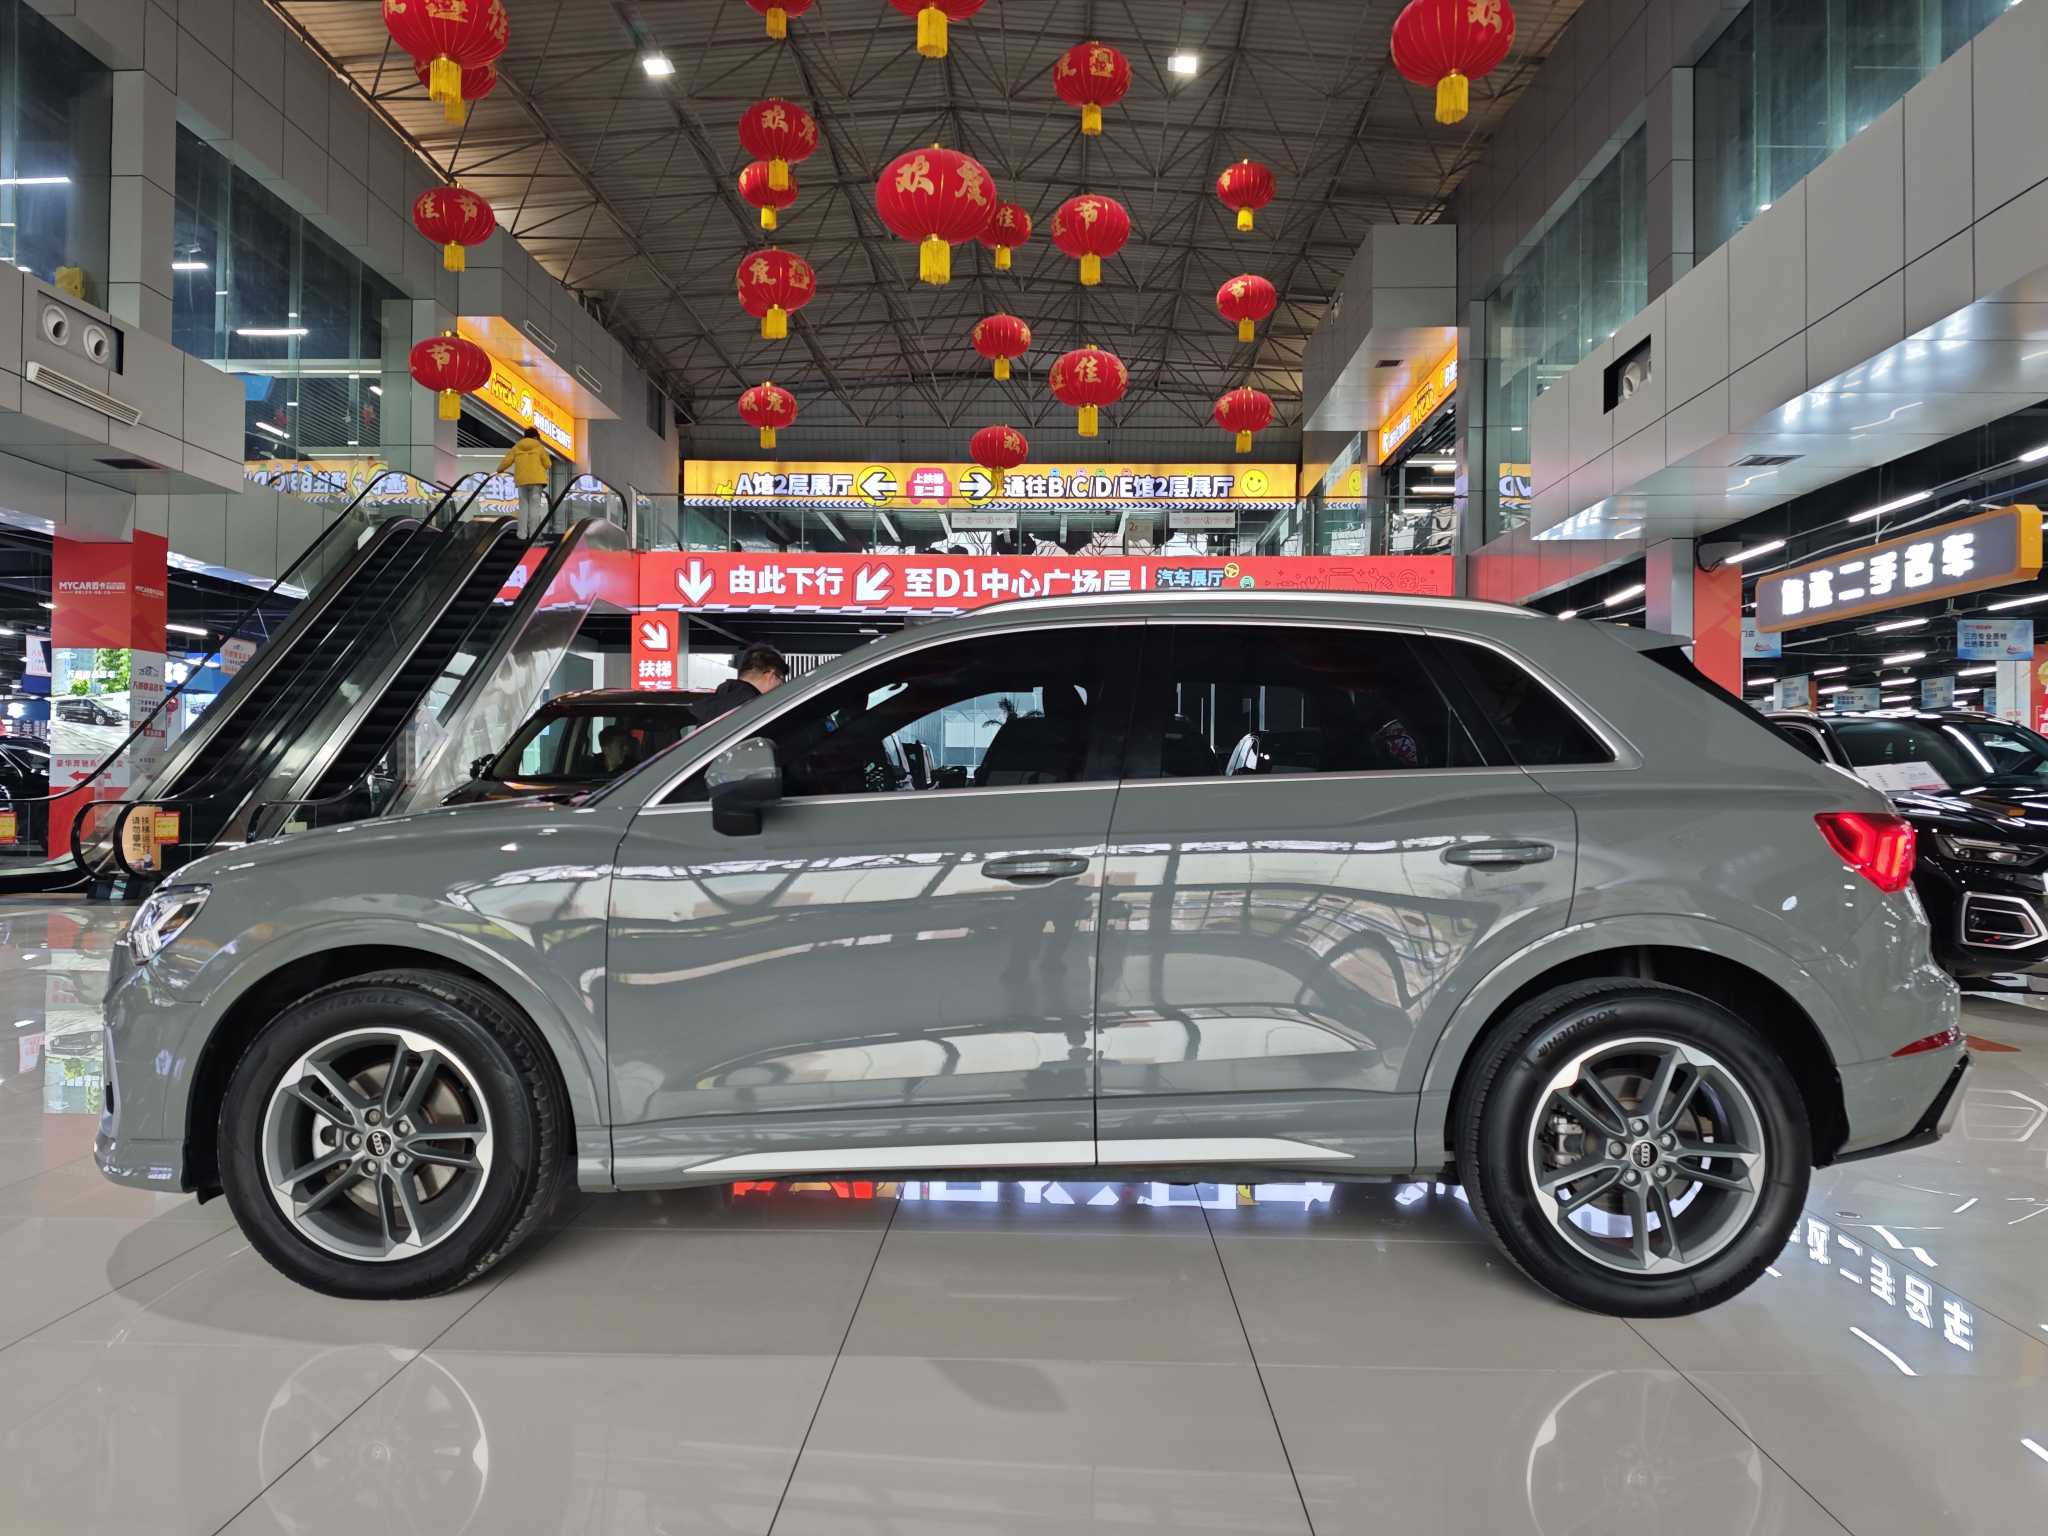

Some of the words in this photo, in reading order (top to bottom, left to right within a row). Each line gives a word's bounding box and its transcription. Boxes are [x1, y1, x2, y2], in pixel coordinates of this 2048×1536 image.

[735, 472, 854, 496] A馆2层展厅
[1003, 475, 1234, 498] 通往B/C/D/E馆2层展厅
[729, 564, 844, 596] 由此下行
[904, 567, 1131, 598] 至D1中心广场层
[1157, 568, 1224, 587] 汽车展厅
[638, 660, 672, 678] 扶梯
